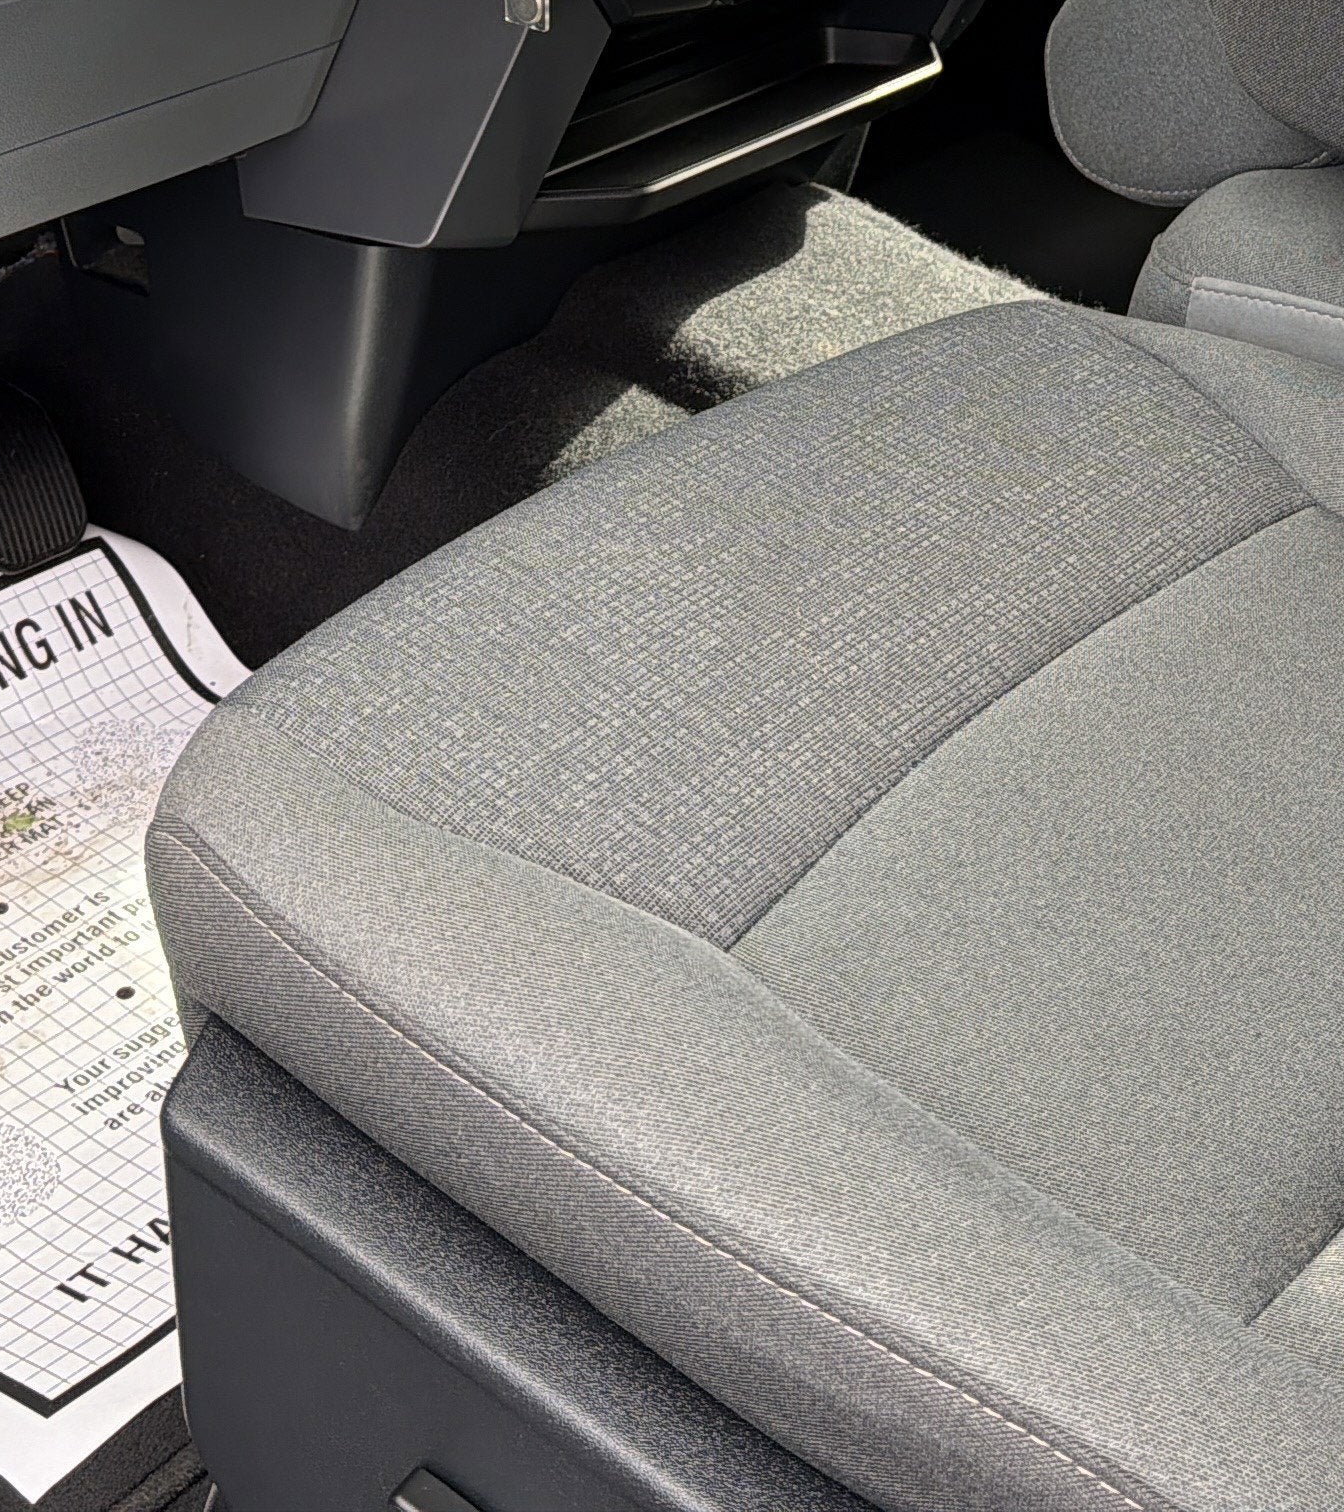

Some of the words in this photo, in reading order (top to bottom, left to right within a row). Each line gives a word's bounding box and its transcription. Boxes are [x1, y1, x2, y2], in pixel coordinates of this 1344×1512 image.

[54, 589, 115, 653] IN
[20, 815, 66, 845] MAT
[11, 984, 54, 1012] the
[52, 943, 116, 984] world
[113, 930, 141, 948] to
[16, 909, 123, 977] important
[55, 1058, 111, 1095] Your
[112, 1016, 180, 1061] sugge
[104, 1101, 144, 1131] are
[55, 1262, 111, 1303] IT
[110, 1218, 171, 1264] HA
